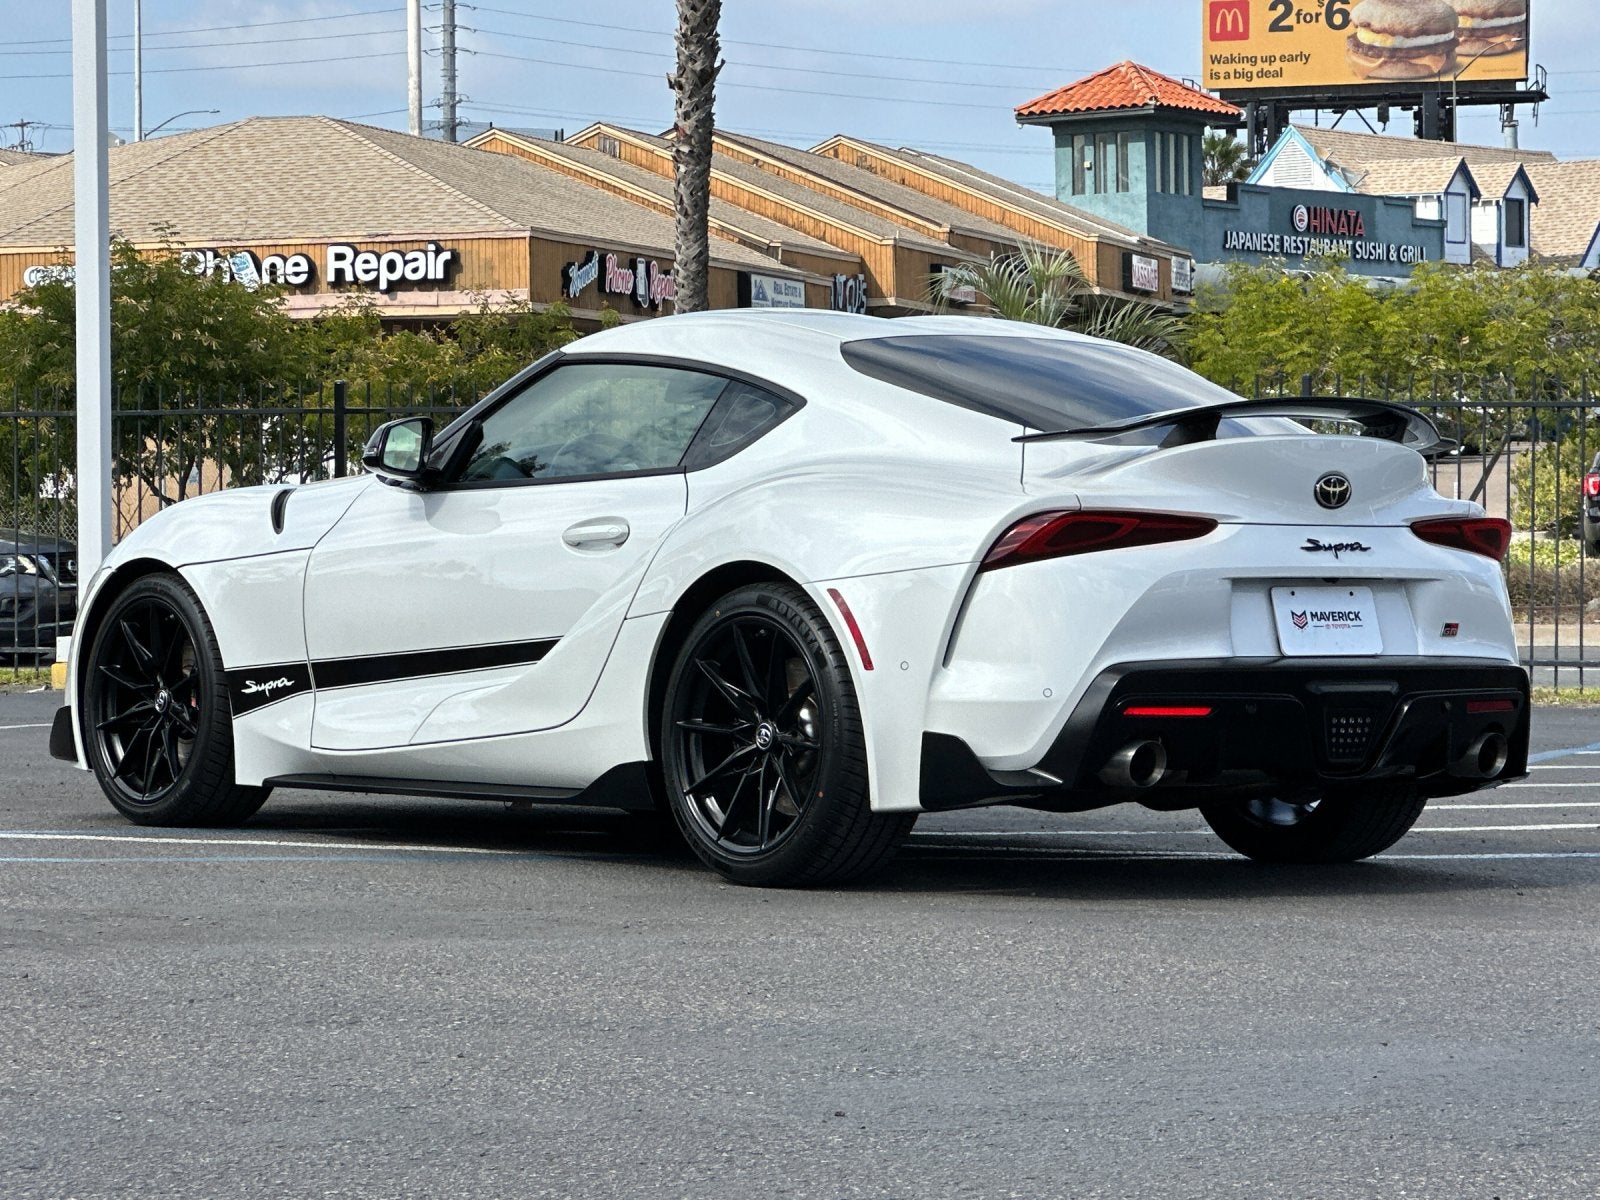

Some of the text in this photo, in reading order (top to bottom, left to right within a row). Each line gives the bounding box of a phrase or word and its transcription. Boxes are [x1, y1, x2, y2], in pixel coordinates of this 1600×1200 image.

[1268, 0, 1294, 32] 2
[1295, 9, 1322, 24] for
[1210, 51, 1311, 66] Waking up early
[1210, 67, 1283, 82] is a big deal
[1309, 205, 1366, 237] HINATA
[1225, 230, 1429, 263] JAPANESE RESTAURANT SUSHI & GRILL
[327, 244, 451, 290] Repair
[605, 253, 634, 295] Phone
[650, 260, 675, 312] Repai
[1300, 538, 1371, 559] Supra
[1309, 611, 1362, 622] MAVERICK
[241, 677, 295, 697] Supra
